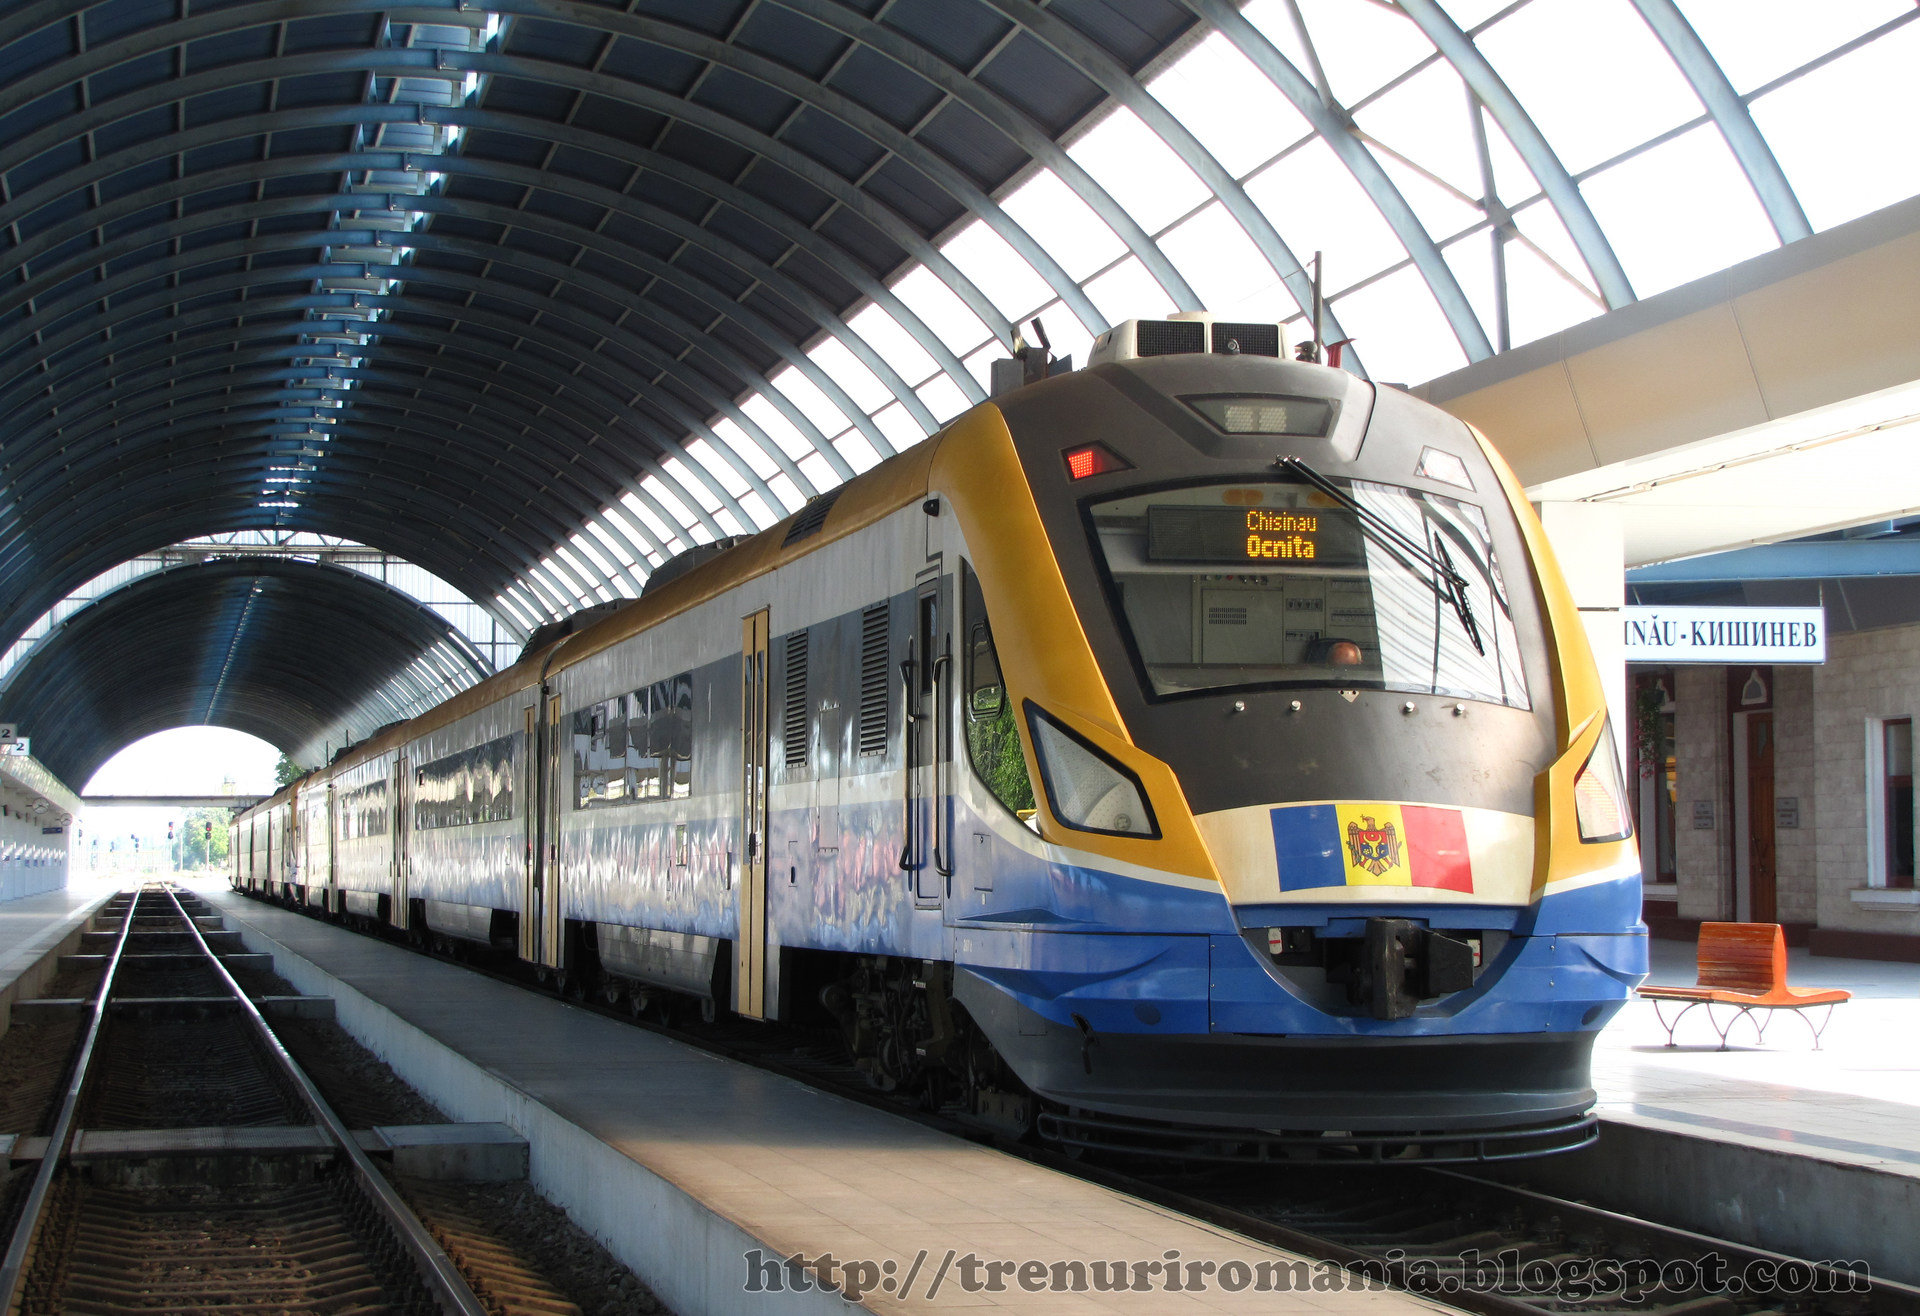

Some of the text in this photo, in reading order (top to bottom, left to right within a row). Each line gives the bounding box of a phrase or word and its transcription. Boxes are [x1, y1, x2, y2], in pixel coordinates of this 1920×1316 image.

[1247, 511, 1317, 532] Chisinau
[1247, 534, 1315, 558] Ocnita
[1, 728, 11, 738] 2
[16, 742, 25, 751] 2
